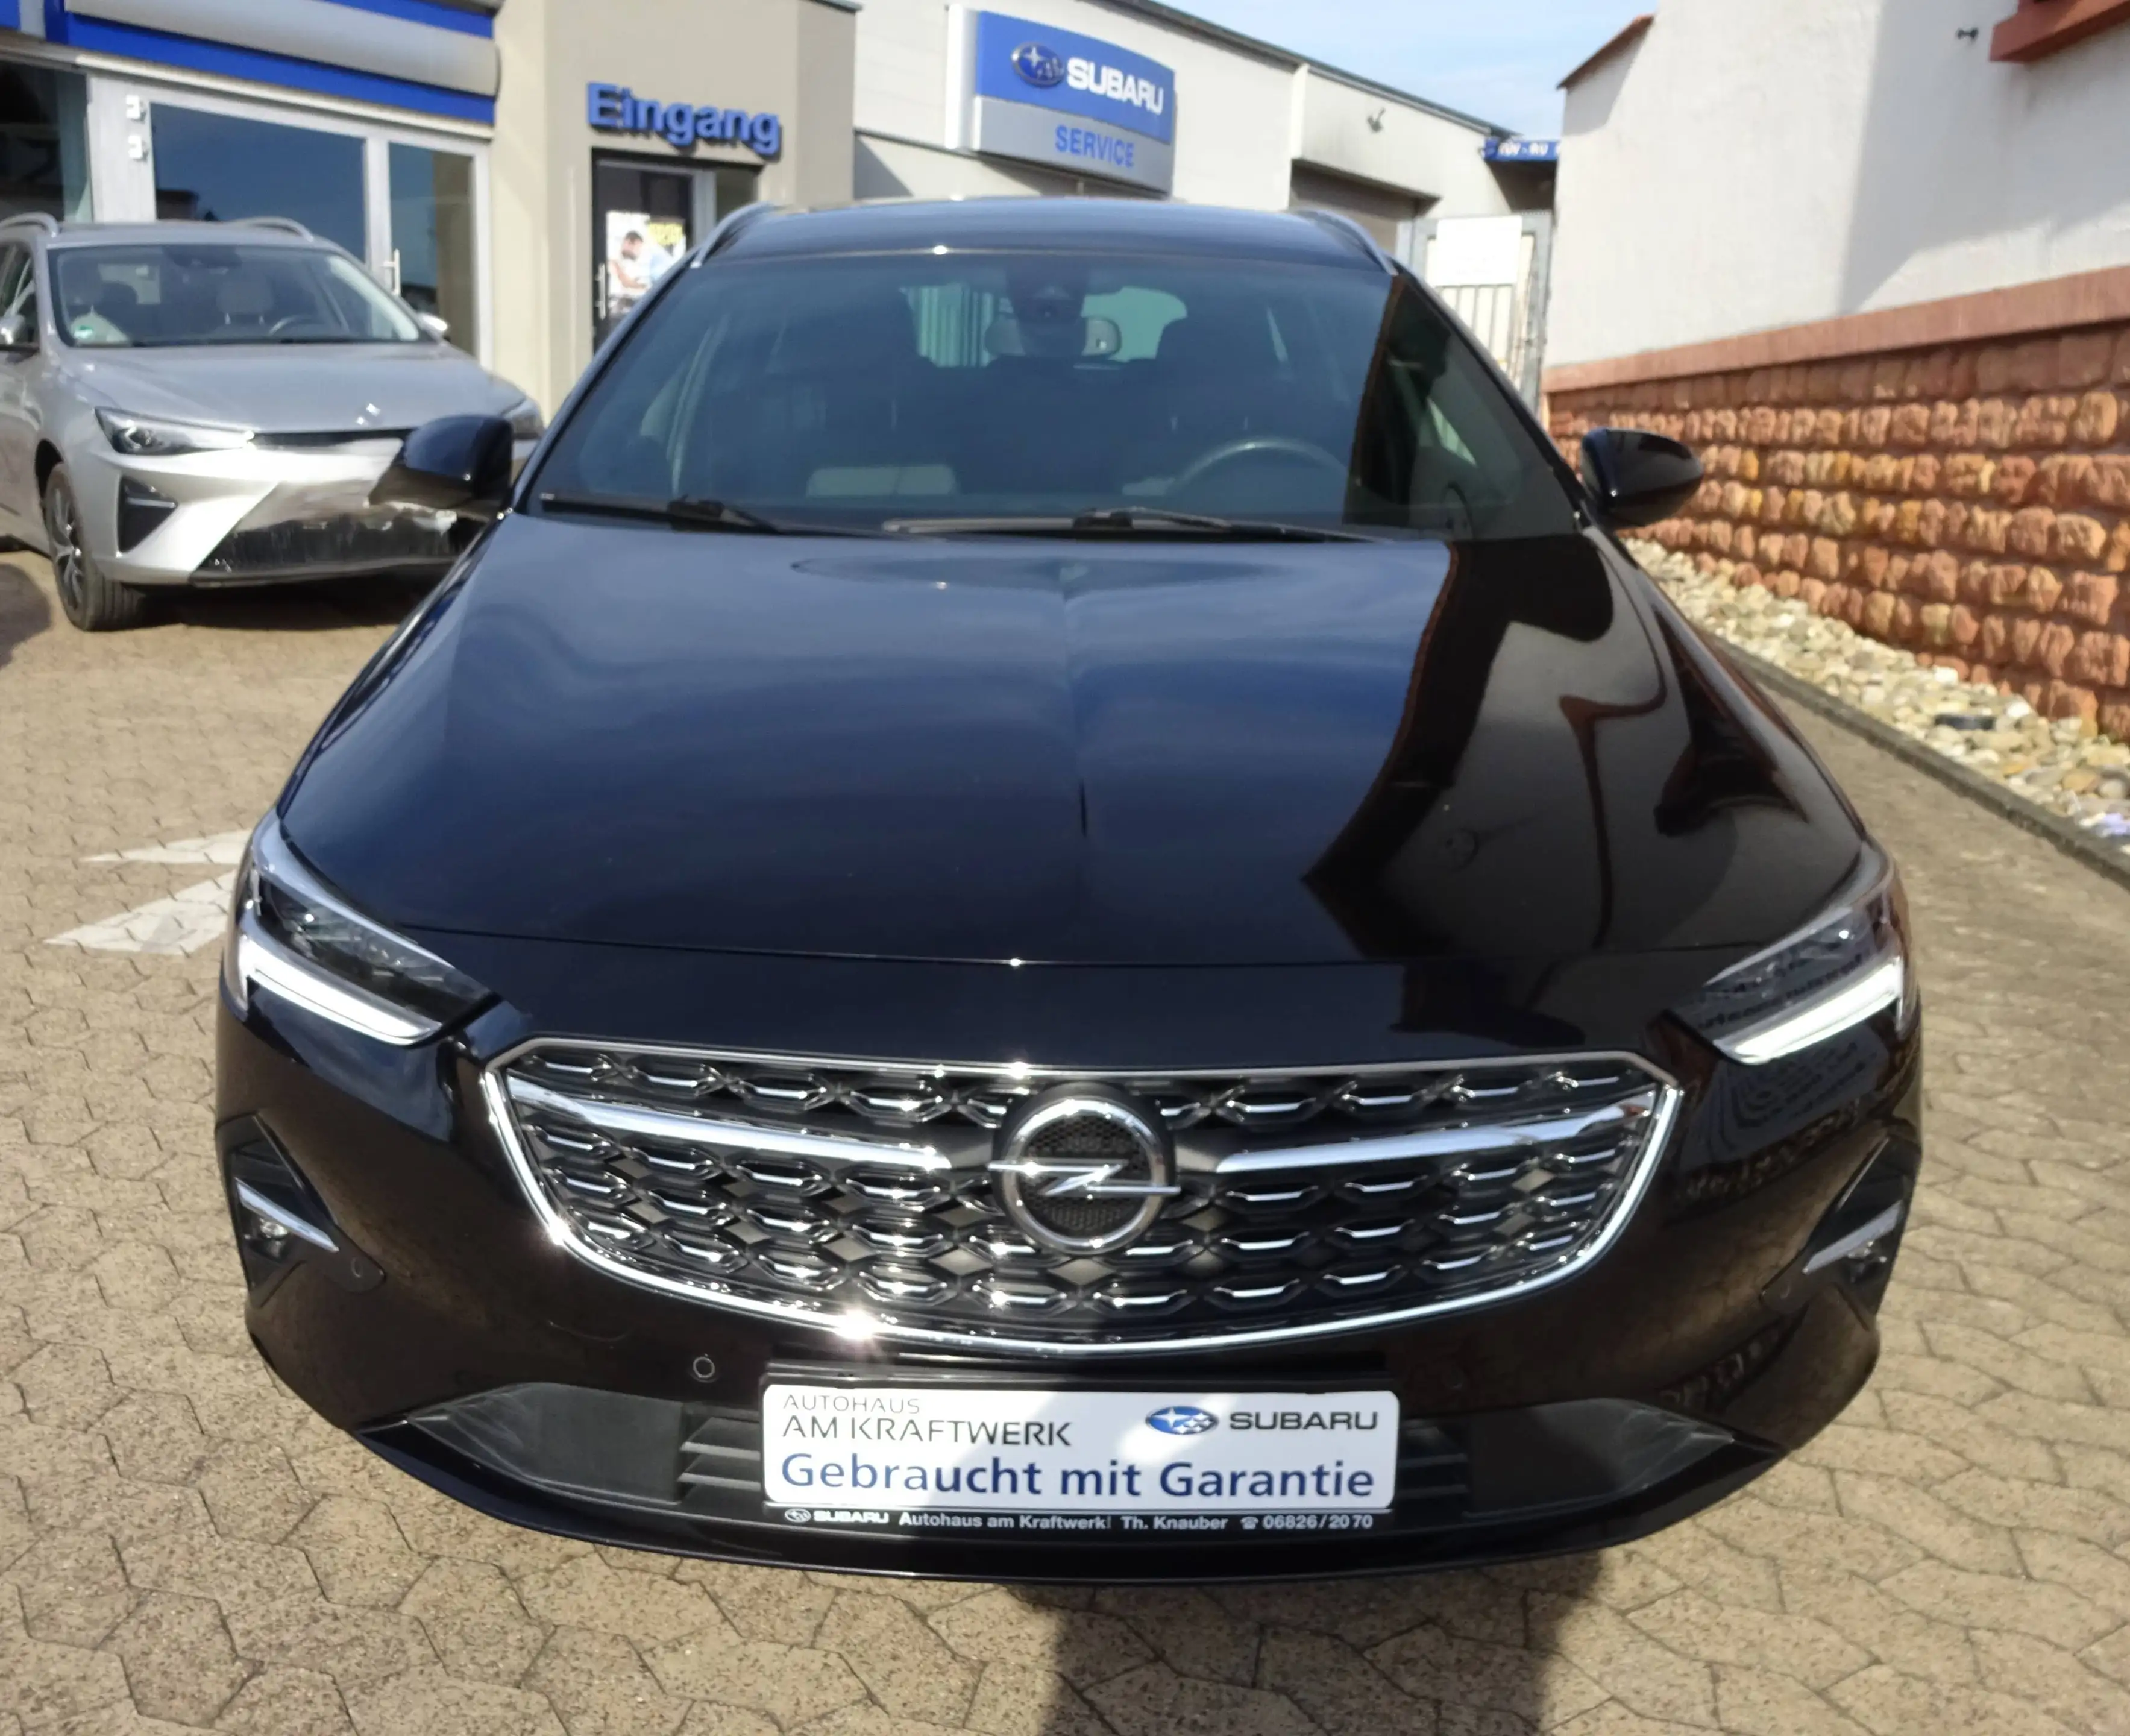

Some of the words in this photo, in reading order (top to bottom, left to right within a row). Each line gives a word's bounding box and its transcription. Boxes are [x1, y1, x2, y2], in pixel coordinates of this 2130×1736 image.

[1066, 57, 1164, 115] SUBARU
[586, 81, 781, 157] Eingang
[1055, 124, 1134, 168] SERVICE
[783, 1394, 920, 1413] AUTOHAUS
[1229, 1411, 1378, 1430] SUBARU
[783, 1415, 838, 1439] AM
[850, 1417, 1073, 1447] KRAFTWERK
[782, 1453, 1043, 1495] Gebraucht
[1061, 1459, 1142, 1497] mit
[1160, 1461, 1375, 1497] Garantie
[814, 1509, 890, 1524] SUBARU
[899, 1512, 982, 1527] Autohaus
[987, 1517, 1014, 1528] am
[1120, 1516, 1148, 1529] Th.
[1153, 1515, 1228, 1529] Knauber
